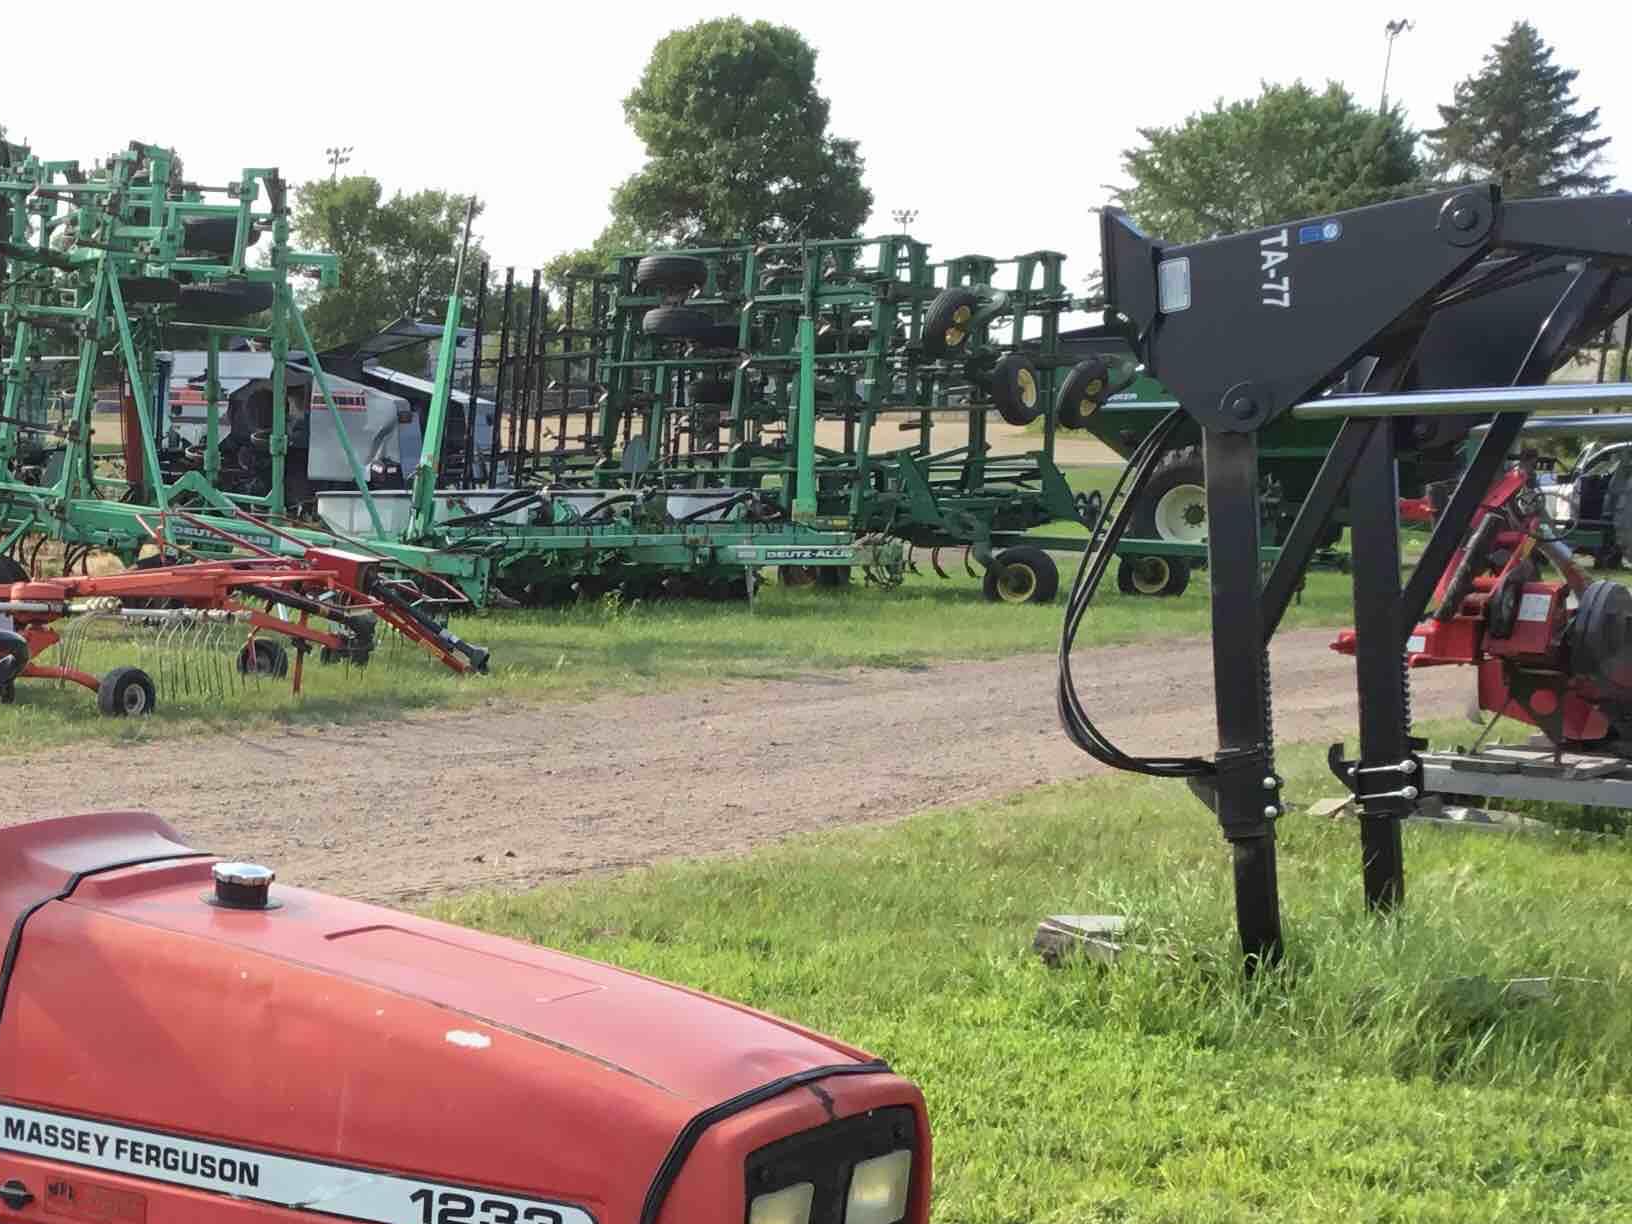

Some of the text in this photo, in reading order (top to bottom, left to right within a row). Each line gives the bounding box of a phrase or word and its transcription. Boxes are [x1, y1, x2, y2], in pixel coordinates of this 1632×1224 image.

[1259, 228, 1291, 308] TA-77
[4, 1116, 260, 1187] MASSEY FERGUSON
